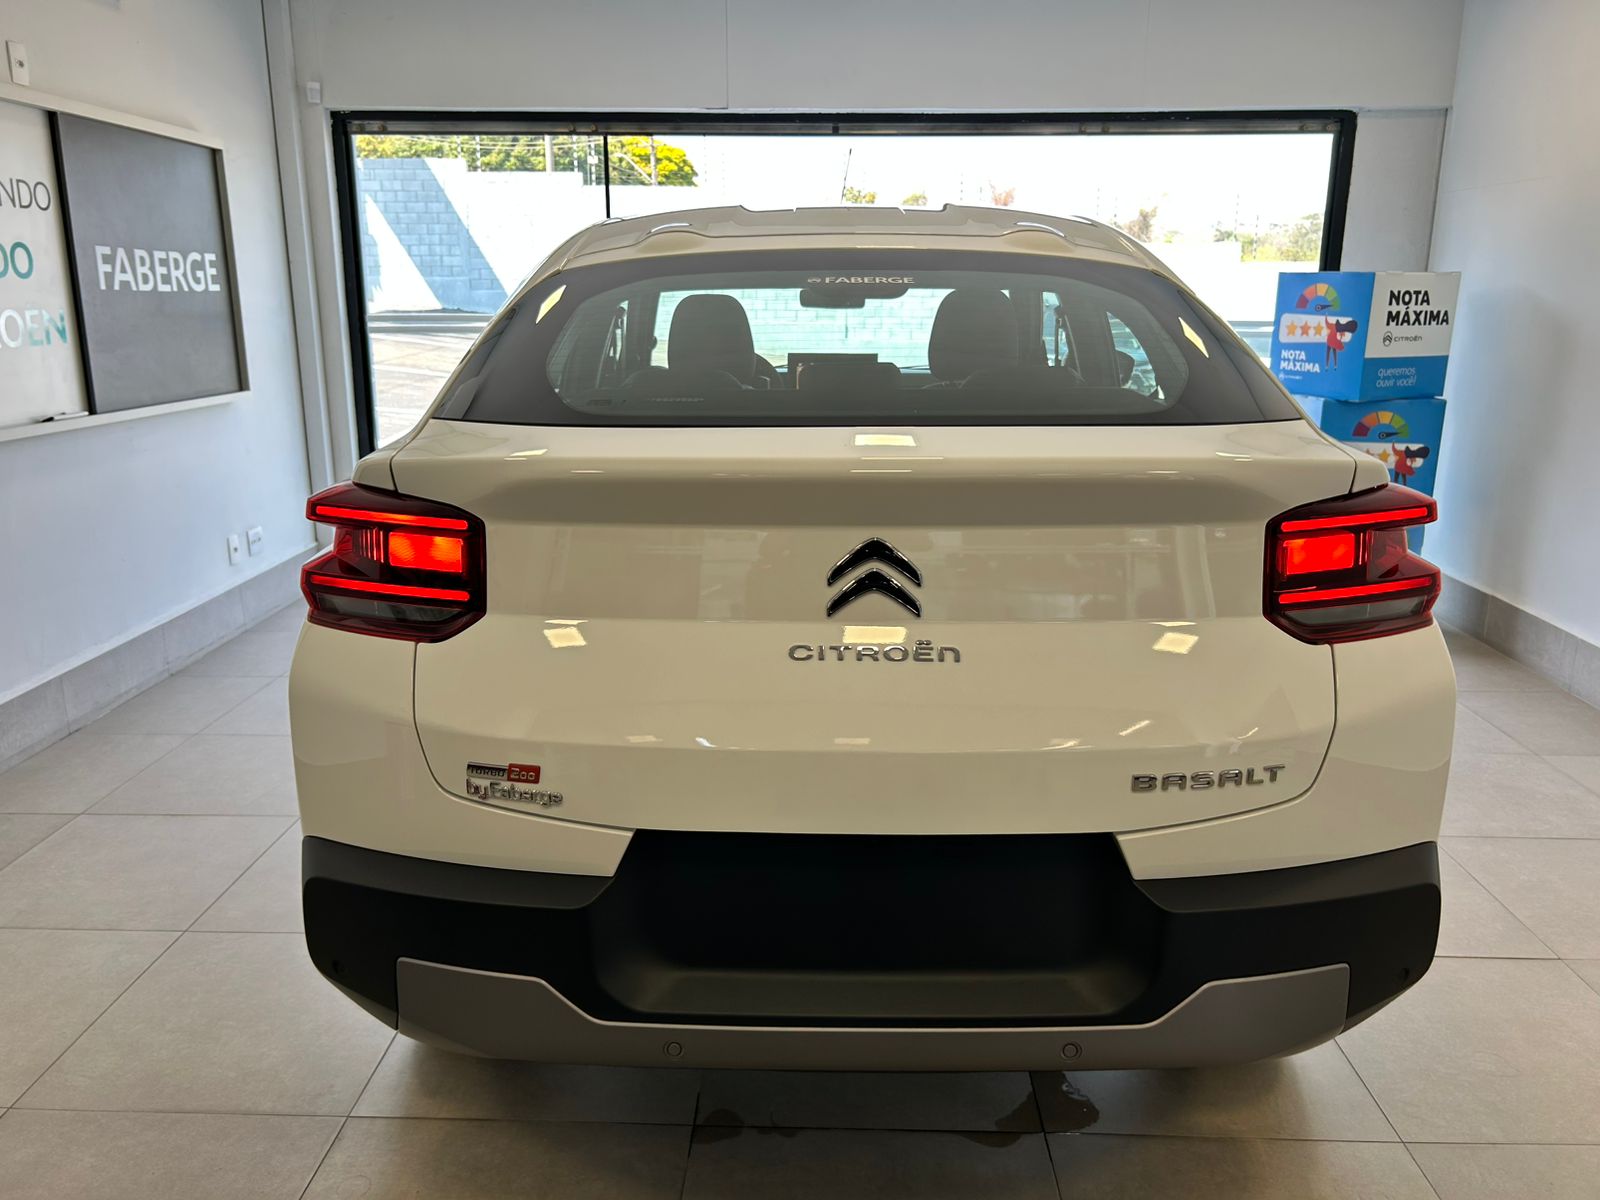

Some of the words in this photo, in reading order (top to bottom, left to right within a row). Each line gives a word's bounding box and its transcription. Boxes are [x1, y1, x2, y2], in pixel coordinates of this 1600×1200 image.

[94, 244, 221, 292] FABERGE
[824, 276, 915, 284] FABERGE
[1388, 290, 1431, 306] NOTA
[1386, 307, 1449, 326] MÁXIMA
[0, 308, 68, 348] OEN
[1281, 349, 1306, 360] NOTA
[1280, 358, 1320, 373] MÁXIMA
[470, 766, 507, 778] TURBO
[510, 767, 536, 781] 200
[1131, 764, 1286, 793] BASALT
